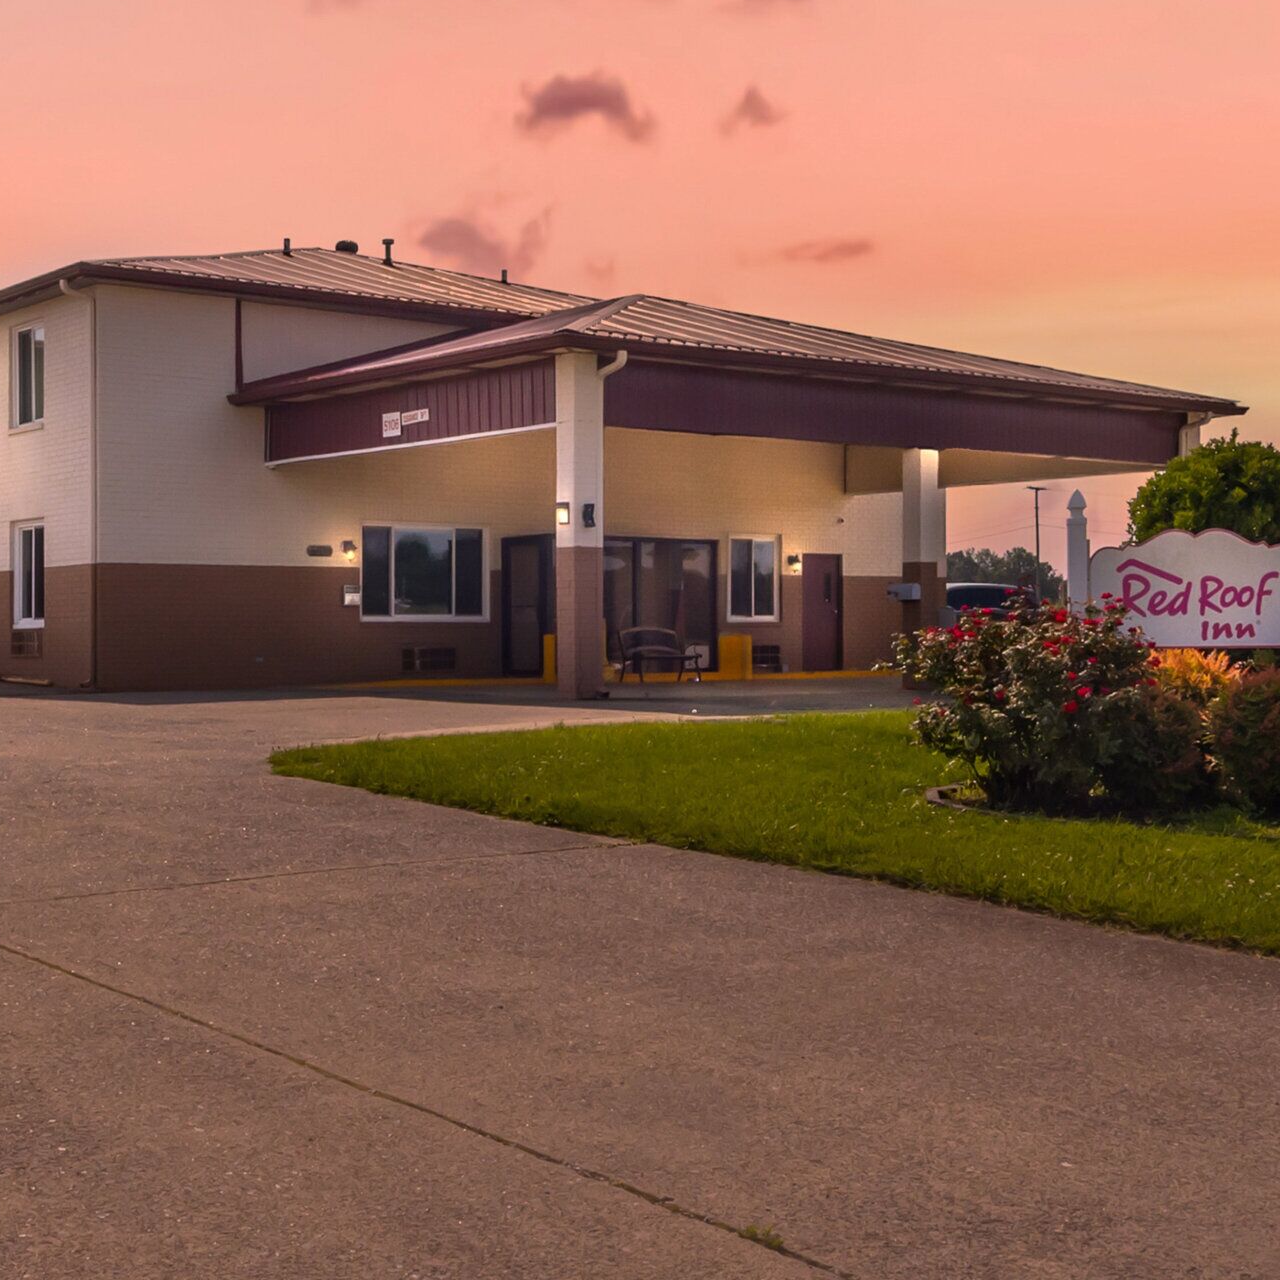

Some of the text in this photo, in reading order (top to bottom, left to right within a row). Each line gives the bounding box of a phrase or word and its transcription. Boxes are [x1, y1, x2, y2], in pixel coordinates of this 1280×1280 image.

[1122, 571, 1279, 617] Red Roof
[1201, 620, 1255, 641] Inn
